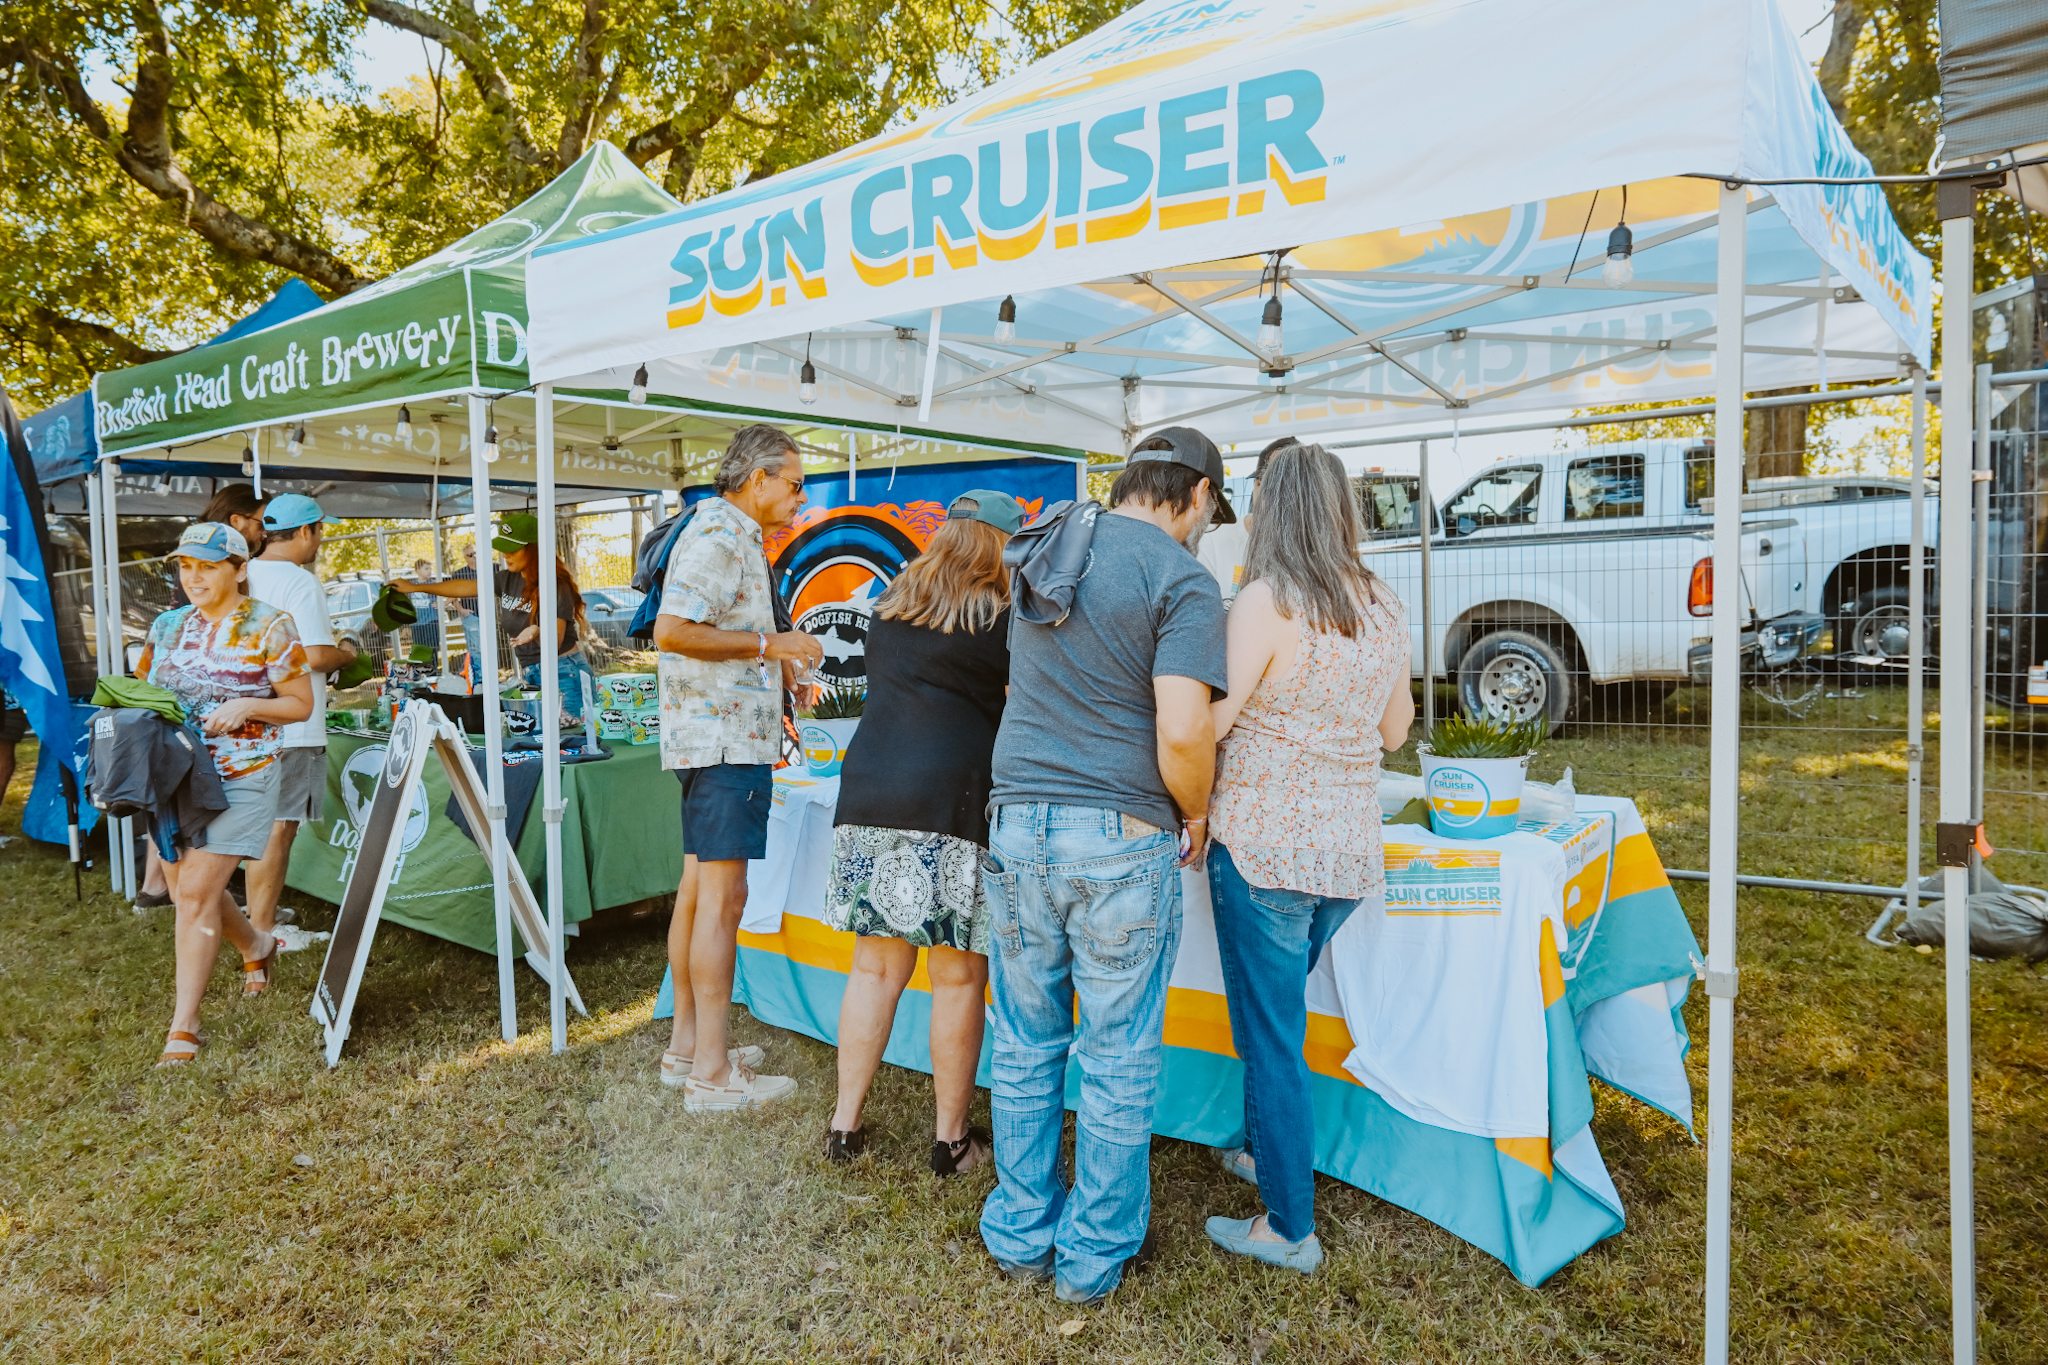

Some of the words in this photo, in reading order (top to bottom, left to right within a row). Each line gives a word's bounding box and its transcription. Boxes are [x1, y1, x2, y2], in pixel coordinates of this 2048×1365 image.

[667, 196, 827, 329] SUN
[850, 69, 1328, 288] CRUISER
[97, 385, 168, 437] Dogfish
[174, 364, 232, 414] Head
[240, 342, 310, 400] Craft
[322, 315, 462, 386] Brewery
[804, 611, 853, 634] DOGFISH
[855, 616, 870, 632] HE
[1434, 780, 1475, 792] CRUISER
[1442, 772, 1462, 783] SUN
[1385, 888, 1422, 906] SUN
[1425, 886, 1502, 906] CRUISER
